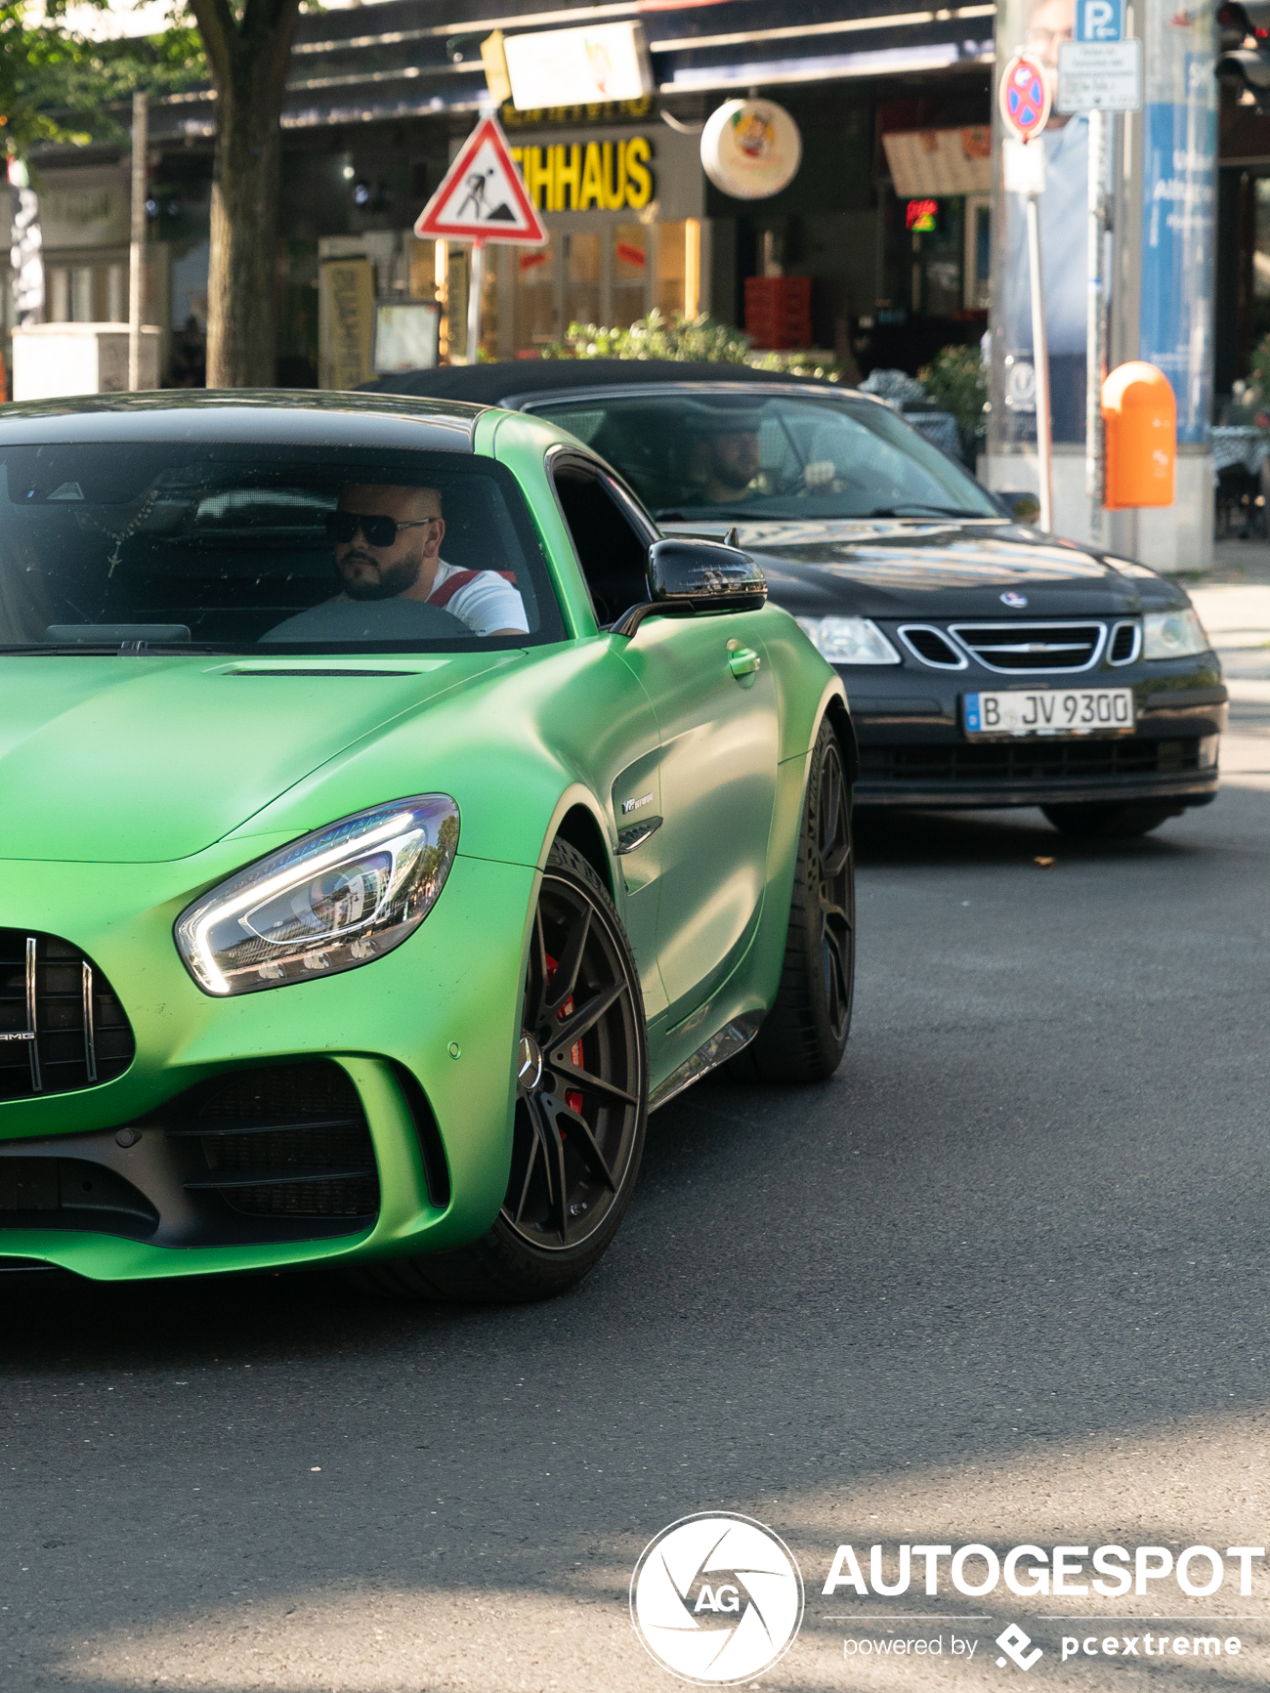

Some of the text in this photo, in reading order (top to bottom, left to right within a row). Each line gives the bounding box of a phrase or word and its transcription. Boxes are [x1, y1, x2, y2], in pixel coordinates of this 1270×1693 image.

[1083, 0, 1114, 40] P
[511, 137, 652, 212] IHHAUS
[984, 698, 1000, 726] B
[1022, 695, 1056, 725] JV
[1063, 694, 1129, 723] 9300
